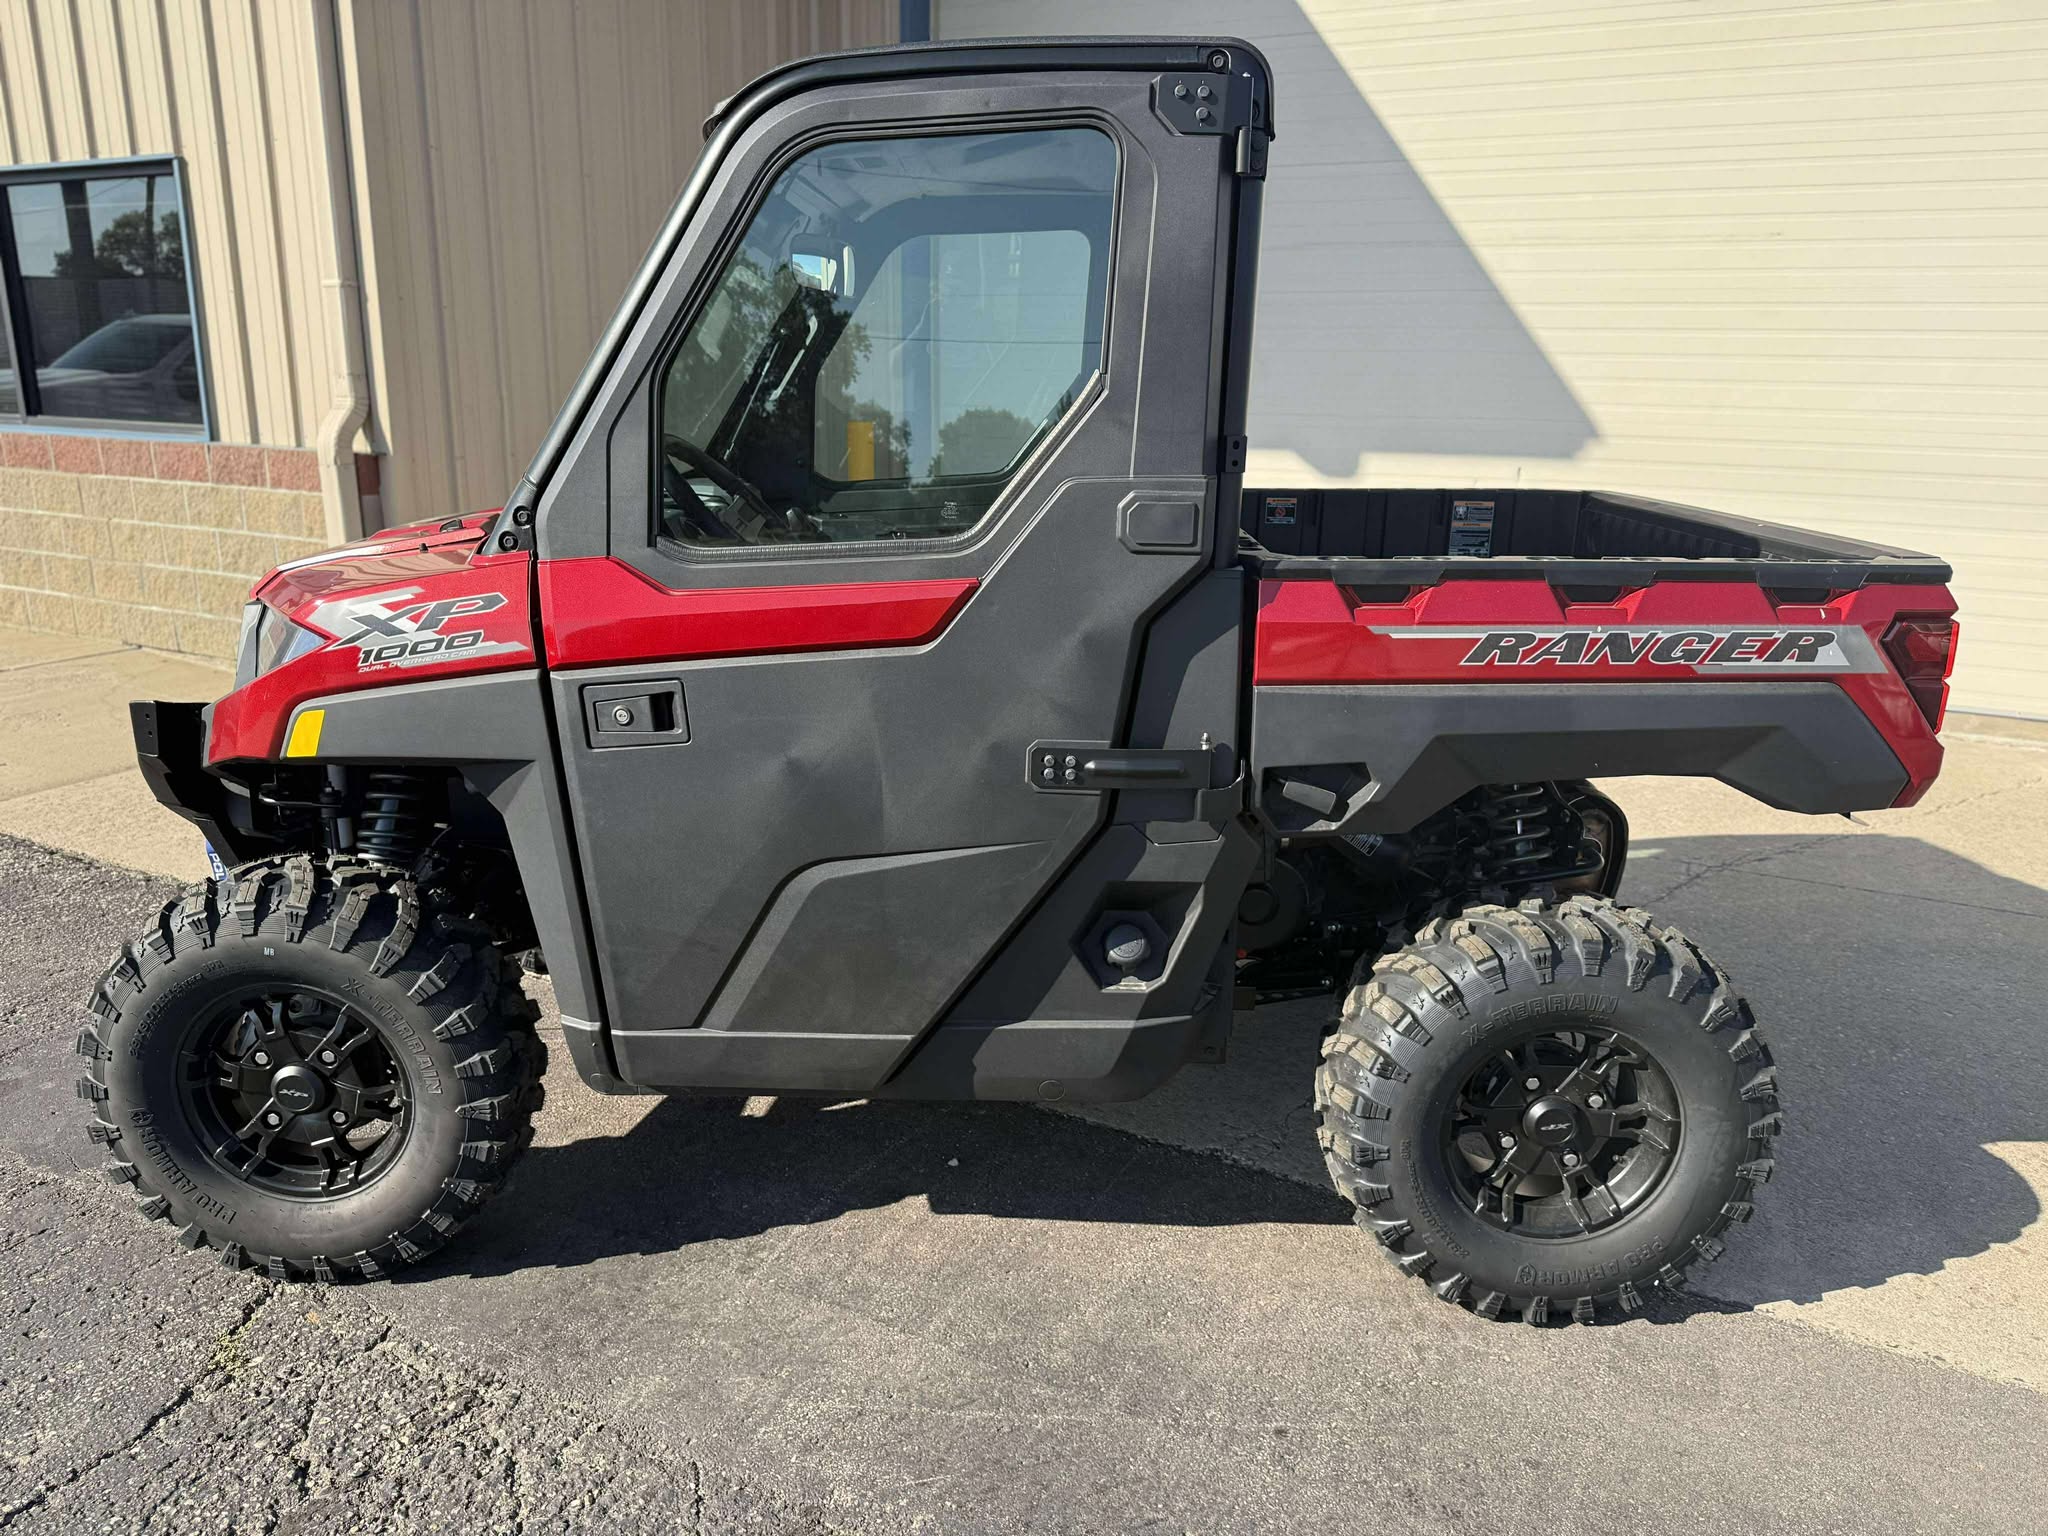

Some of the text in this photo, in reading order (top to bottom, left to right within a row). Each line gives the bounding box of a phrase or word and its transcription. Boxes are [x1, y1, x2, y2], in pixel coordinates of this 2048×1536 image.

[326, 592, 508, 651] XP
[358, 631, 483, 667] 1000
[359, 649, 477, 673] DUAL OVERHEAD CAM
[1459, 631, 1836, 666] RANGER
[209, 853, 226, 881] POL
[340, 976, 444, 1095] X-TERRAIN
[1461, 992, 1619, 1047] X-TERRAIN
[137, 1126, 238, 1225] PRO ARMOR
[1537, 1234, 1666, 1286] PRO ARMOR
